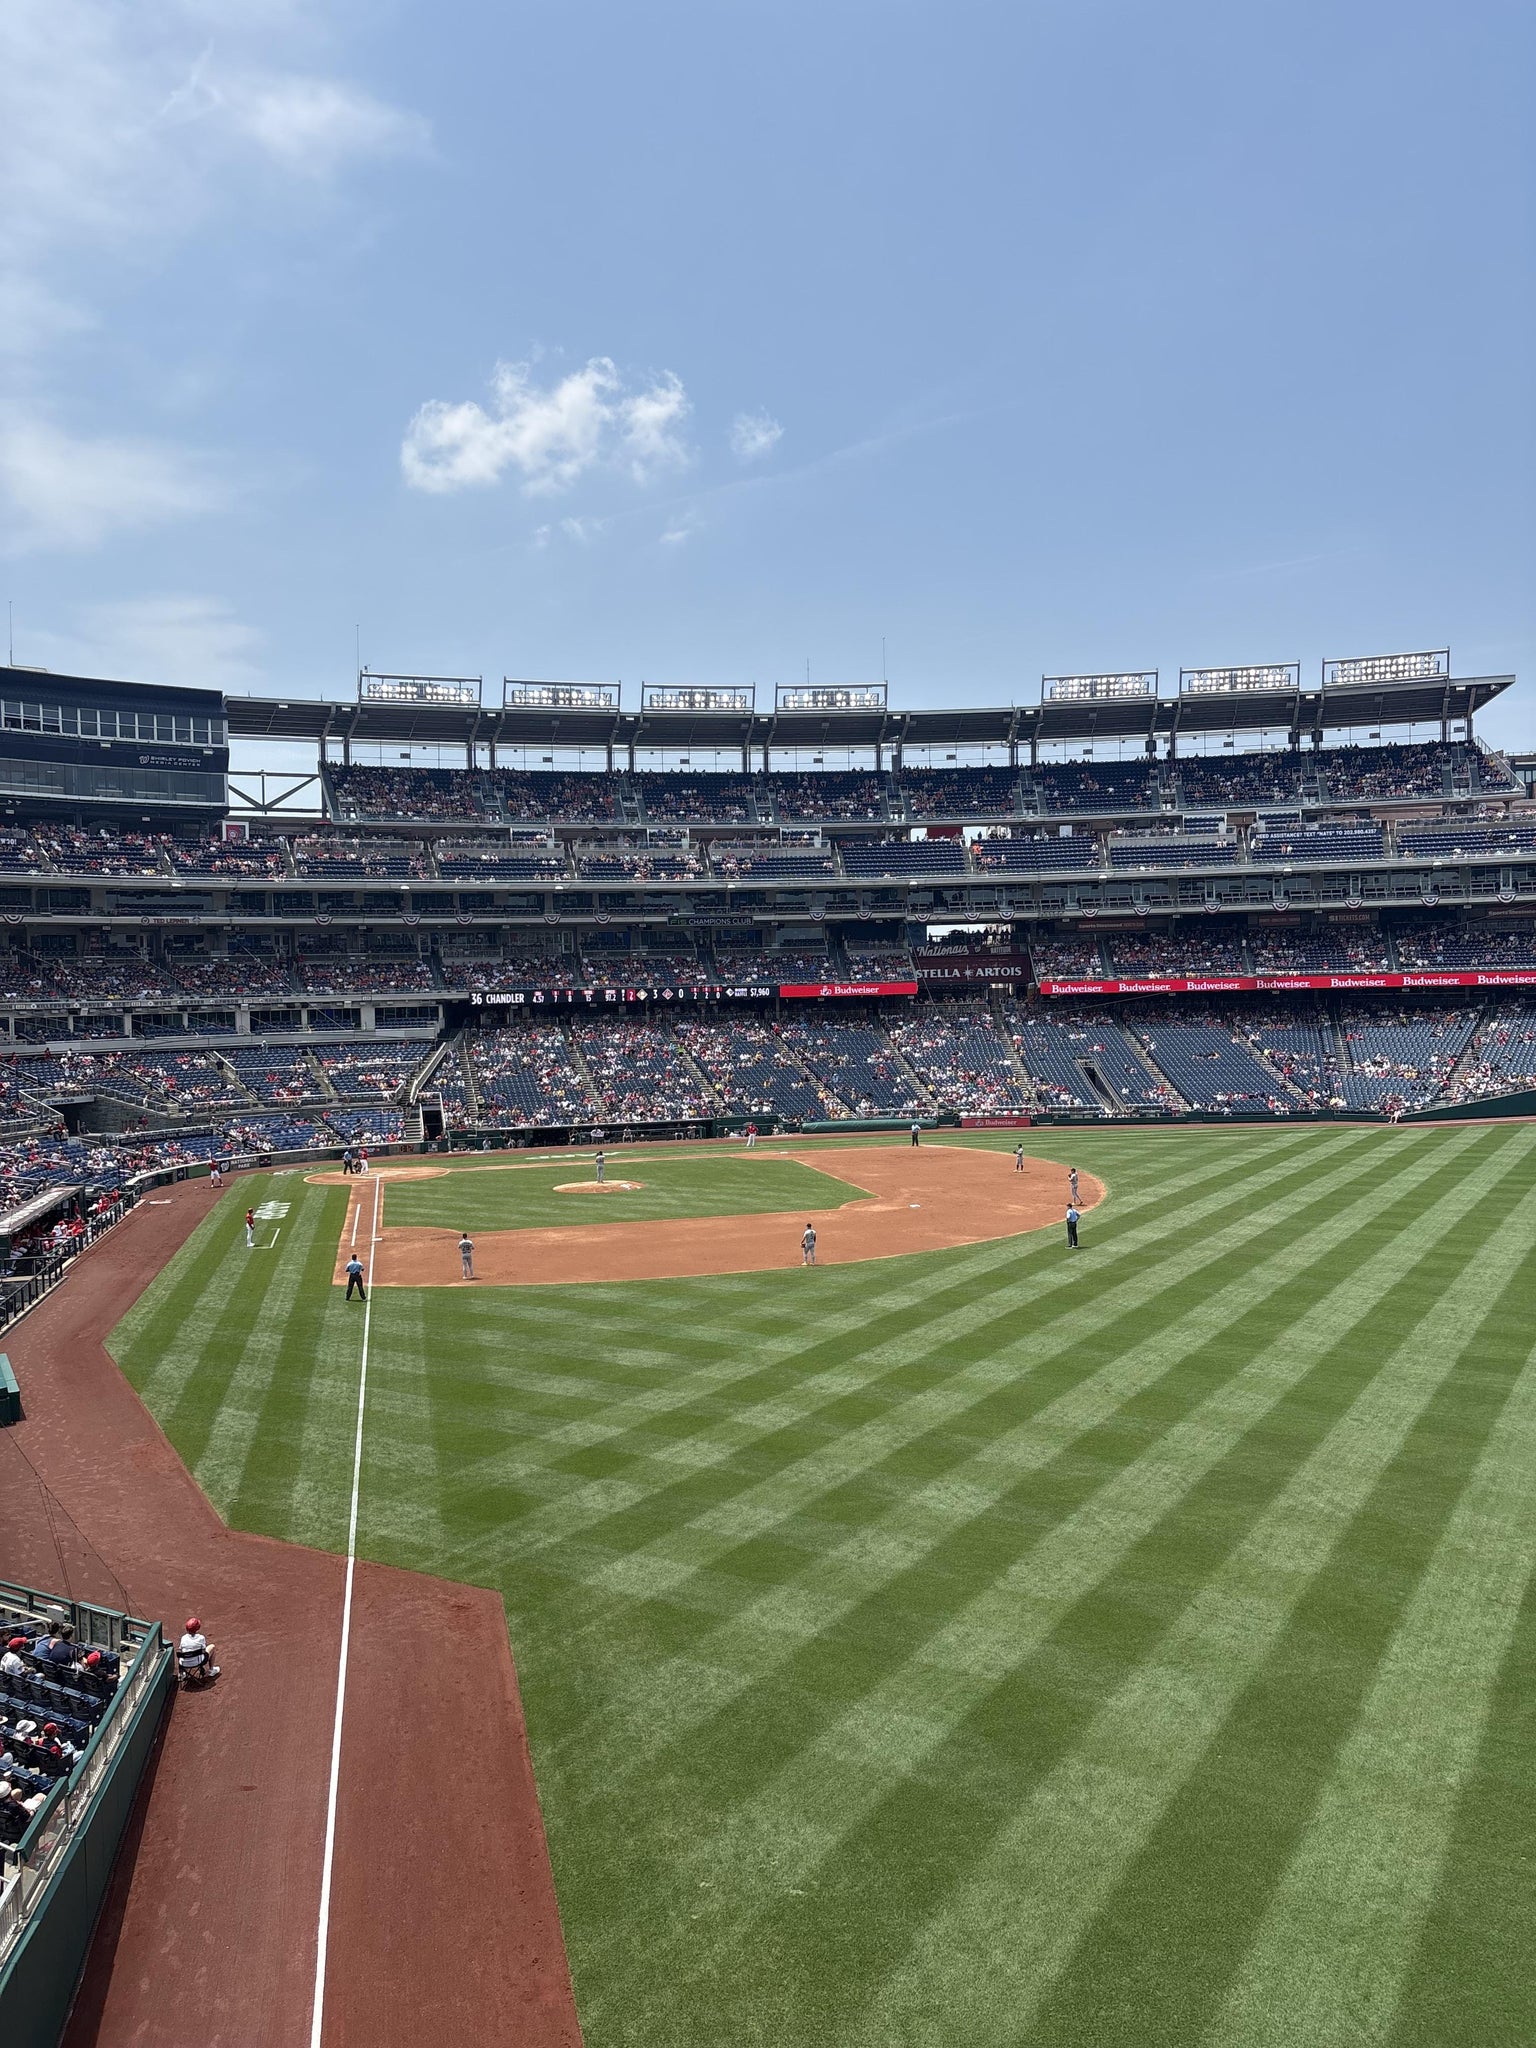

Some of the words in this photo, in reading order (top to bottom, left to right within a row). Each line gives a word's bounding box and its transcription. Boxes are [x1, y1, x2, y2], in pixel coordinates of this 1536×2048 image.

[916, 944, 970, 957] Nationals
[915, 969, 961, 979] STELLA
[975, 967, 1022, 977] ARTOIS
[652, 989, 658, 1000] 3
[678, 988, 684, 999] 0
[750, 987, 770, 998] $7,960
[834, 986, 880, 995] Budweiser
[471, 993, 483, 1005] 36
[486, 993, 525, 1004] CHANDLER
[532, 995, 545, 1003] 4.57
[553, 995, 558, 1003] 7
[585, 994, 592, 1002] 15
[693, 992, 698, 1000] 2
[704, 991, 709, 999] 2
[716, 991, 721, 999] 0
[230, 1157, 257, 1165] NATIONALS
